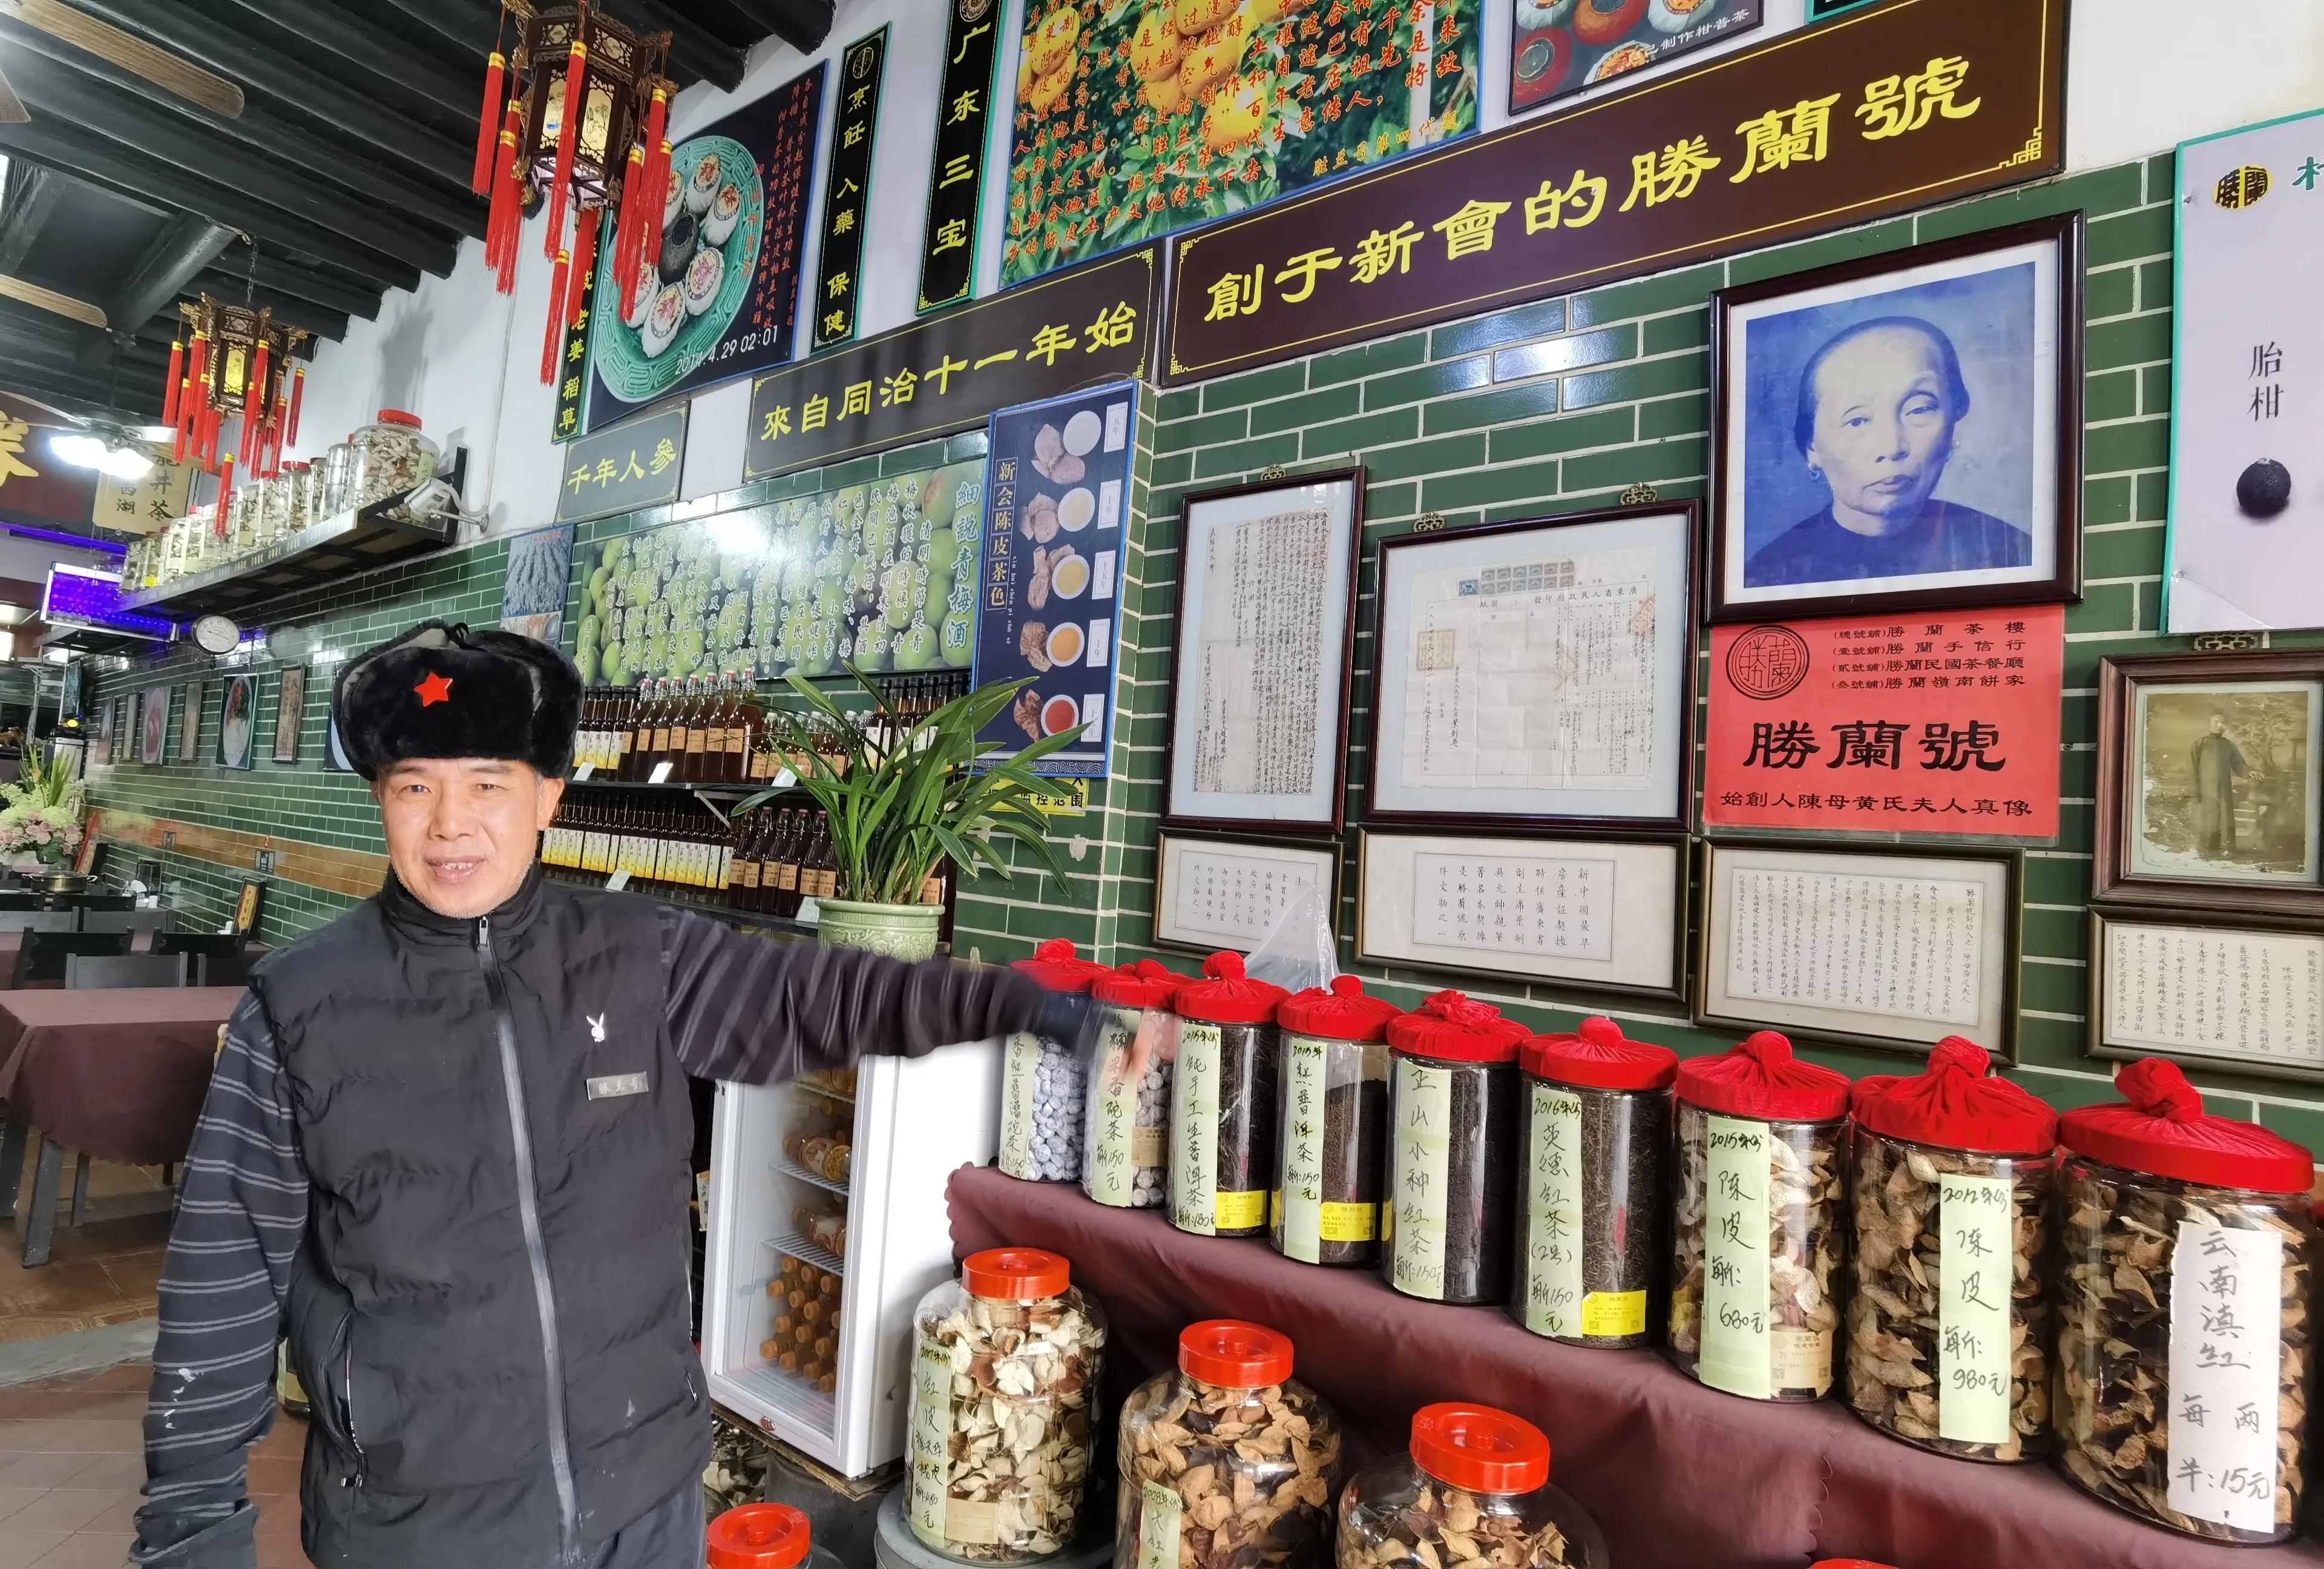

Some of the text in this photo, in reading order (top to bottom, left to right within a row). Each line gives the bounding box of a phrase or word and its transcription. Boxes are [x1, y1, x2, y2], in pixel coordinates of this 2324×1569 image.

[1025, 0, 1132, 55] 粤菜制作的
[934, 22, 991, 255] 广东三宝
[1204, 56, 1981, 323] 創于新會的勝蘭號
[740, 325, 778, 353] 02:01
[760, 300, 1138, 442] 來自同治十一年始
[2247, 340, 2284, 423] 胎柑
[989, 462, 1016, 610] 新会陈皮茶色
[1742, 719, 2006, 772] 勝蘭號
[1295, 1064, 1315, 1163] 熟普洱茶
[1106, 1176, 1121, 1192] 元
[1302, 1186, 1318, 1200] 元
[1403, 1069, 1437, 1257] 正山小种红茶
[1718, 1169, 1757, 1250] 陈皮
[1955, 1228, 2001, 1312] 陈皮
[2196, 1230, 2253, 1370] 云南滇红
[1544, 1314, 1564, 1334] 元
[1719, 1301, 1765, 1335] 680元
[1952, 1368, 2008, 1398] 980元
